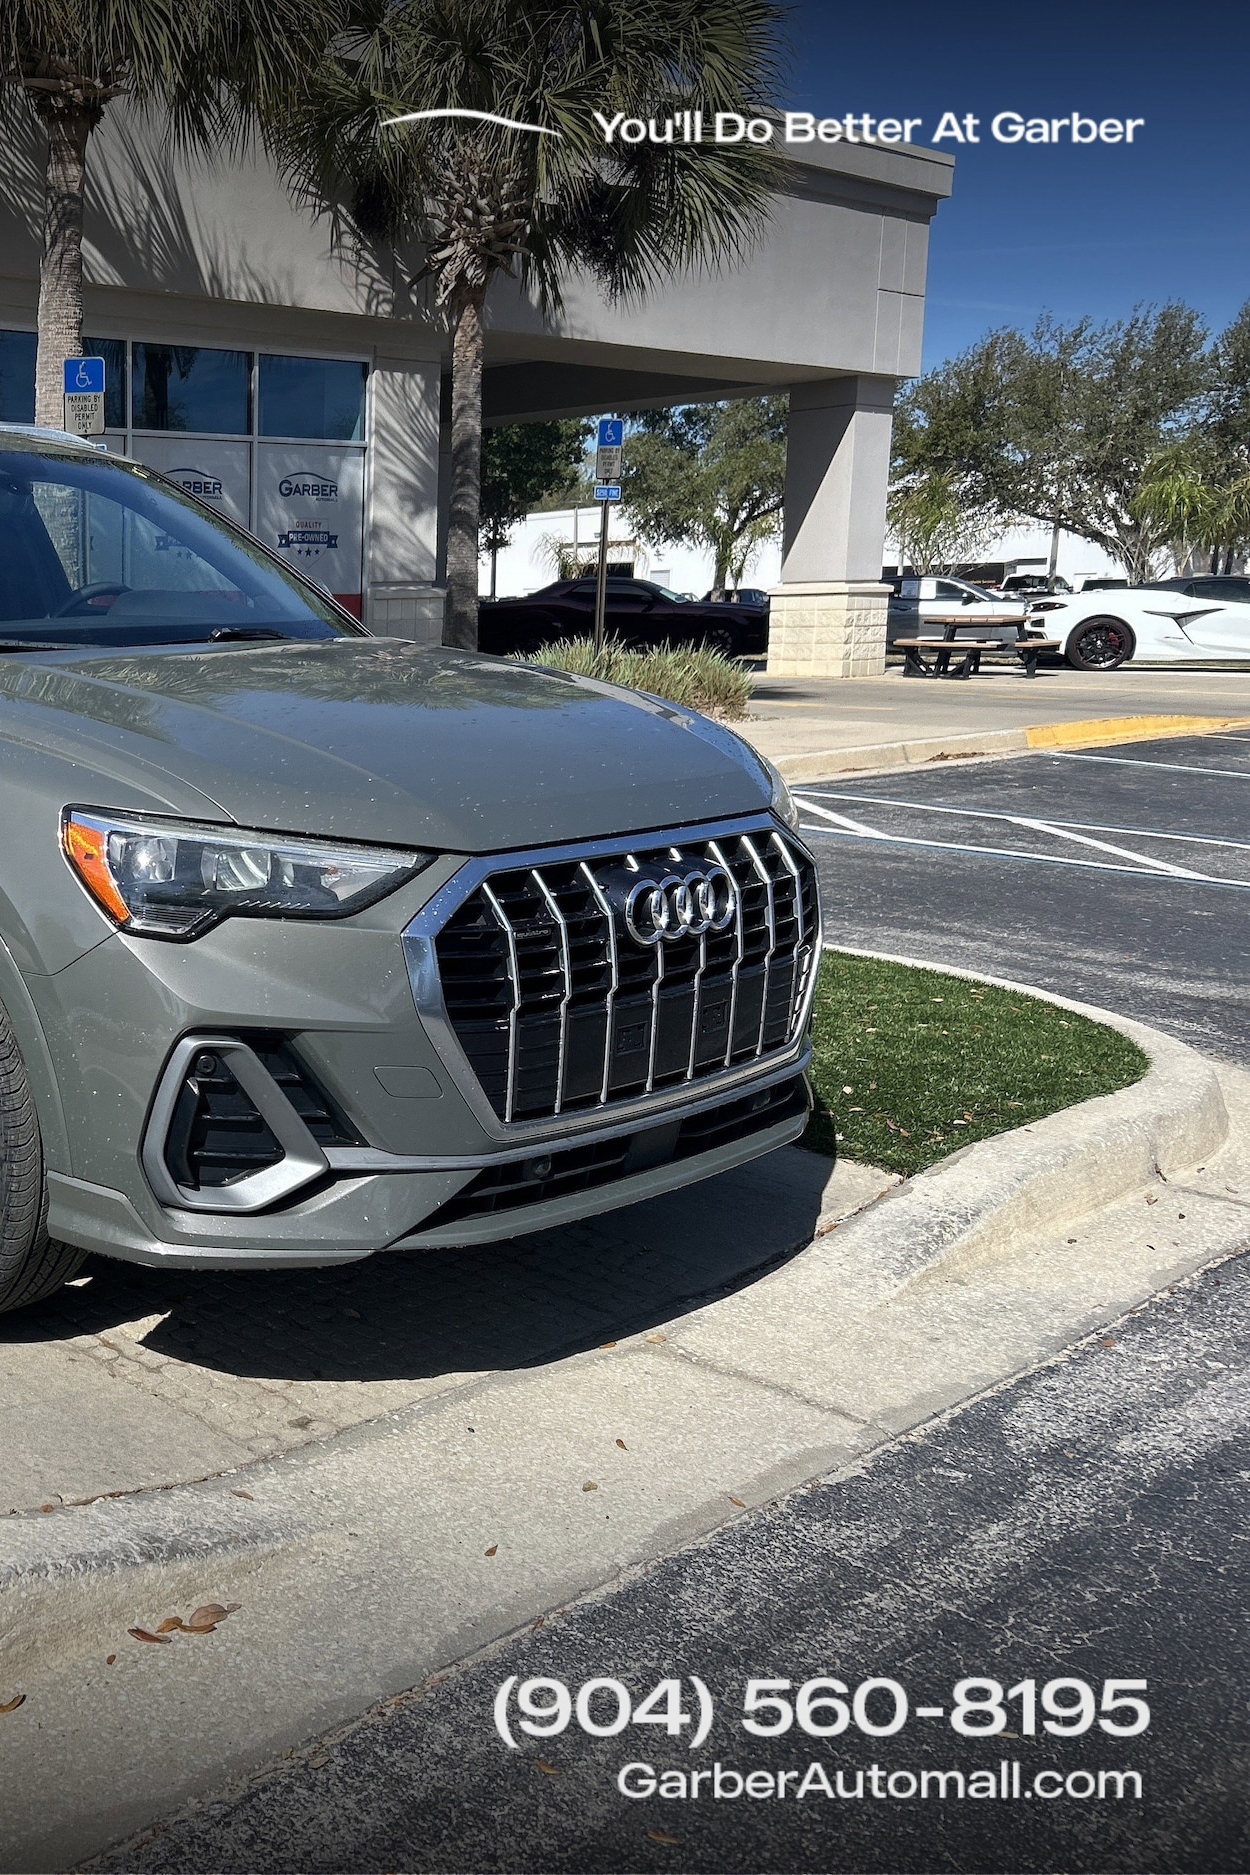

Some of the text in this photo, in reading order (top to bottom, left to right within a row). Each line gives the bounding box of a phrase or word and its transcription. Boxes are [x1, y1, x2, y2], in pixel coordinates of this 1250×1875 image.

[67, 394, 101, 404] PARKING BY
[71, 404, 98, 413] DISABLED
[74, 412, 95, 421] PERMIT
[77, 421, 92, 430] ONLY
[176, 480, 223, 495] RBER
[279, 479, 338, 497] GARBER
[295, 521, 322, 529] QUALITY
[289, 533, 329, 543] PRE-OWNED
